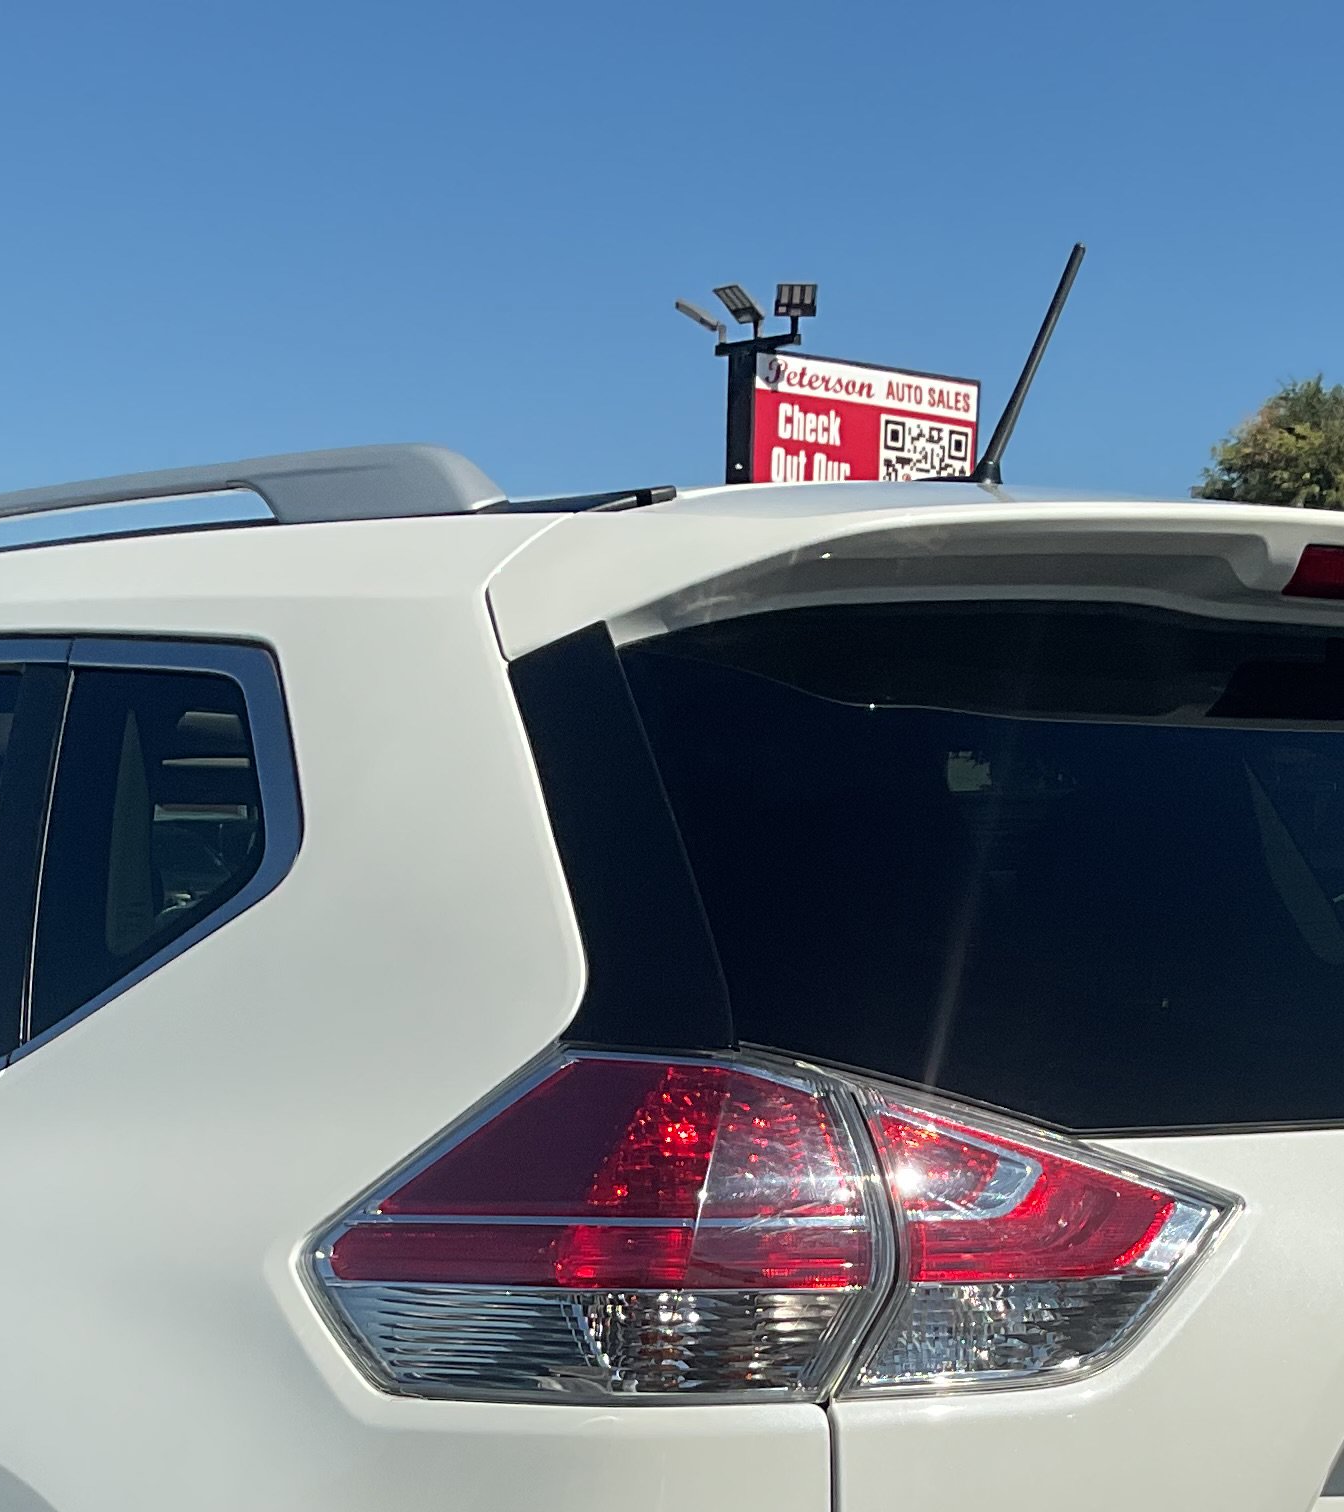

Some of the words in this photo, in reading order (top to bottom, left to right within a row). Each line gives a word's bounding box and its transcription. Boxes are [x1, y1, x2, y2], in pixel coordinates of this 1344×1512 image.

[765, 358, 874, 398] Peterson
[886, 380, 923, 405] AUTO
[928, 387, 970, 413] SALES
[778, 402, 841, 446] Check
[771, 446, 806, 482] Out
[813, 452, 851, 482] Our
